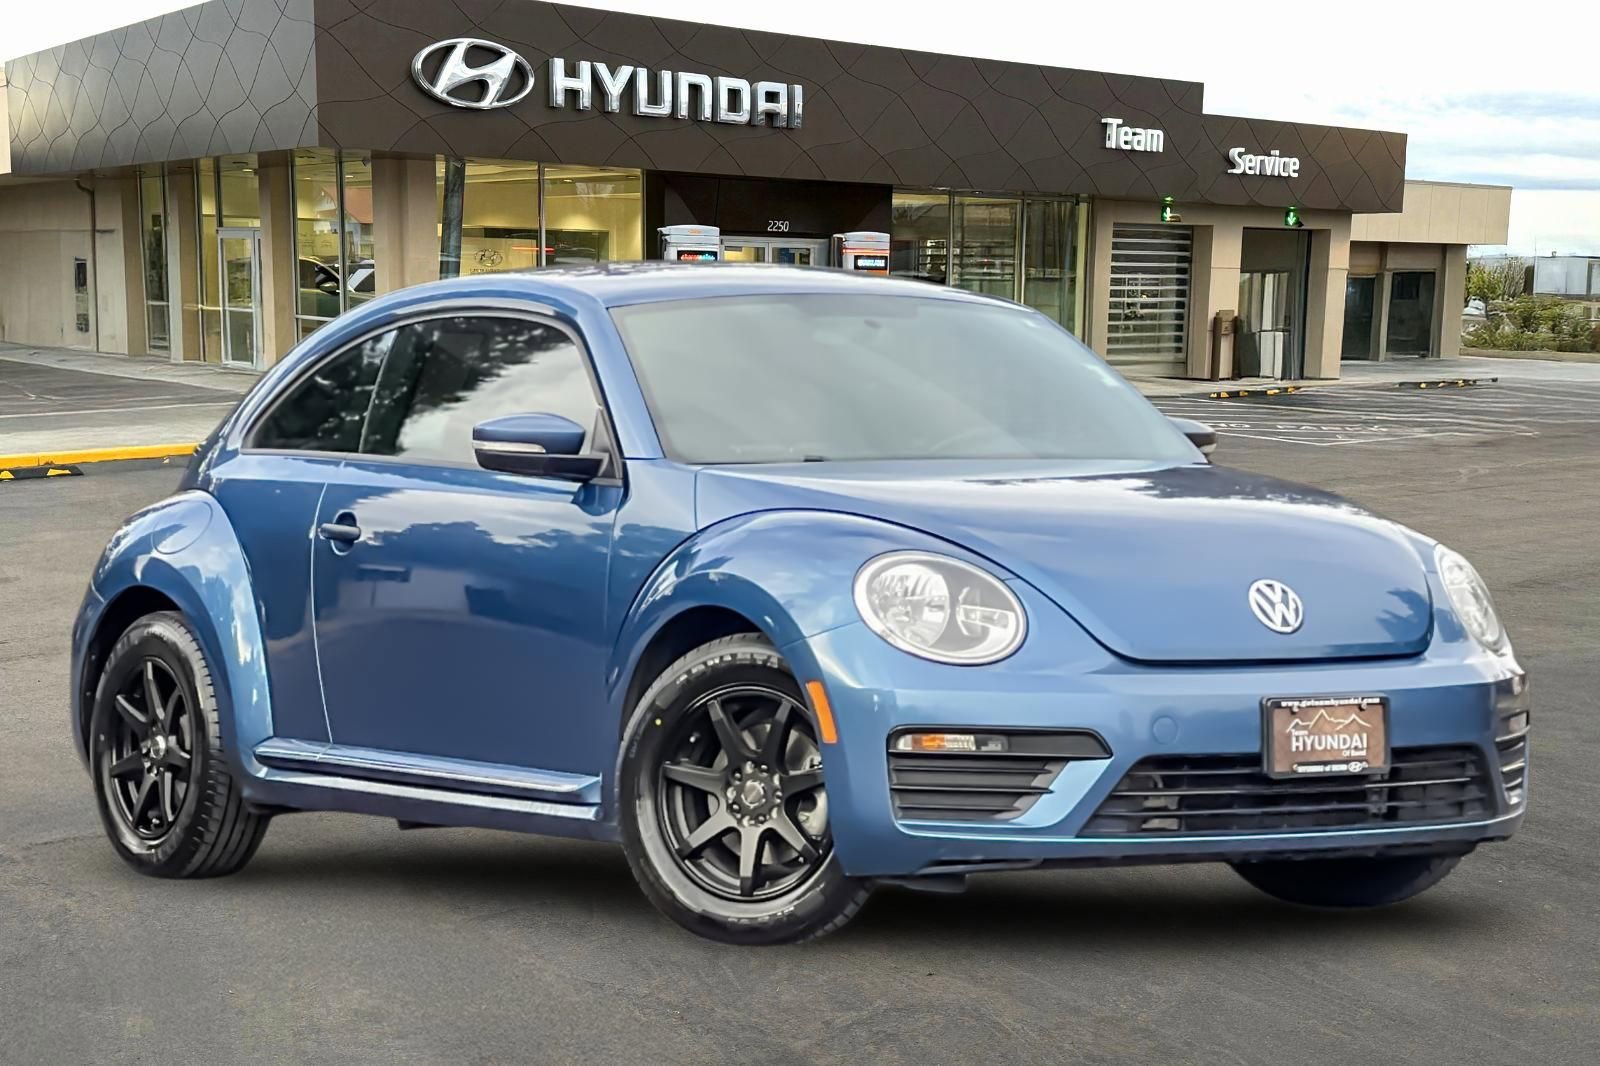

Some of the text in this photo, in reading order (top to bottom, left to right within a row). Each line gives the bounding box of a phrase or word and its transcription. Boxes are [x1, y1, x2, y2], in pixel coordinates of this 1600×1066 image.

[549, 57, 803, 129] HYUNDAI
[1101, 117, 1164, 153] Team
[1227, 147, 1300, 178] Service
[767, 220, 790, 232] 2250
[1291, 733, 1368, 752] HYUNDAI
